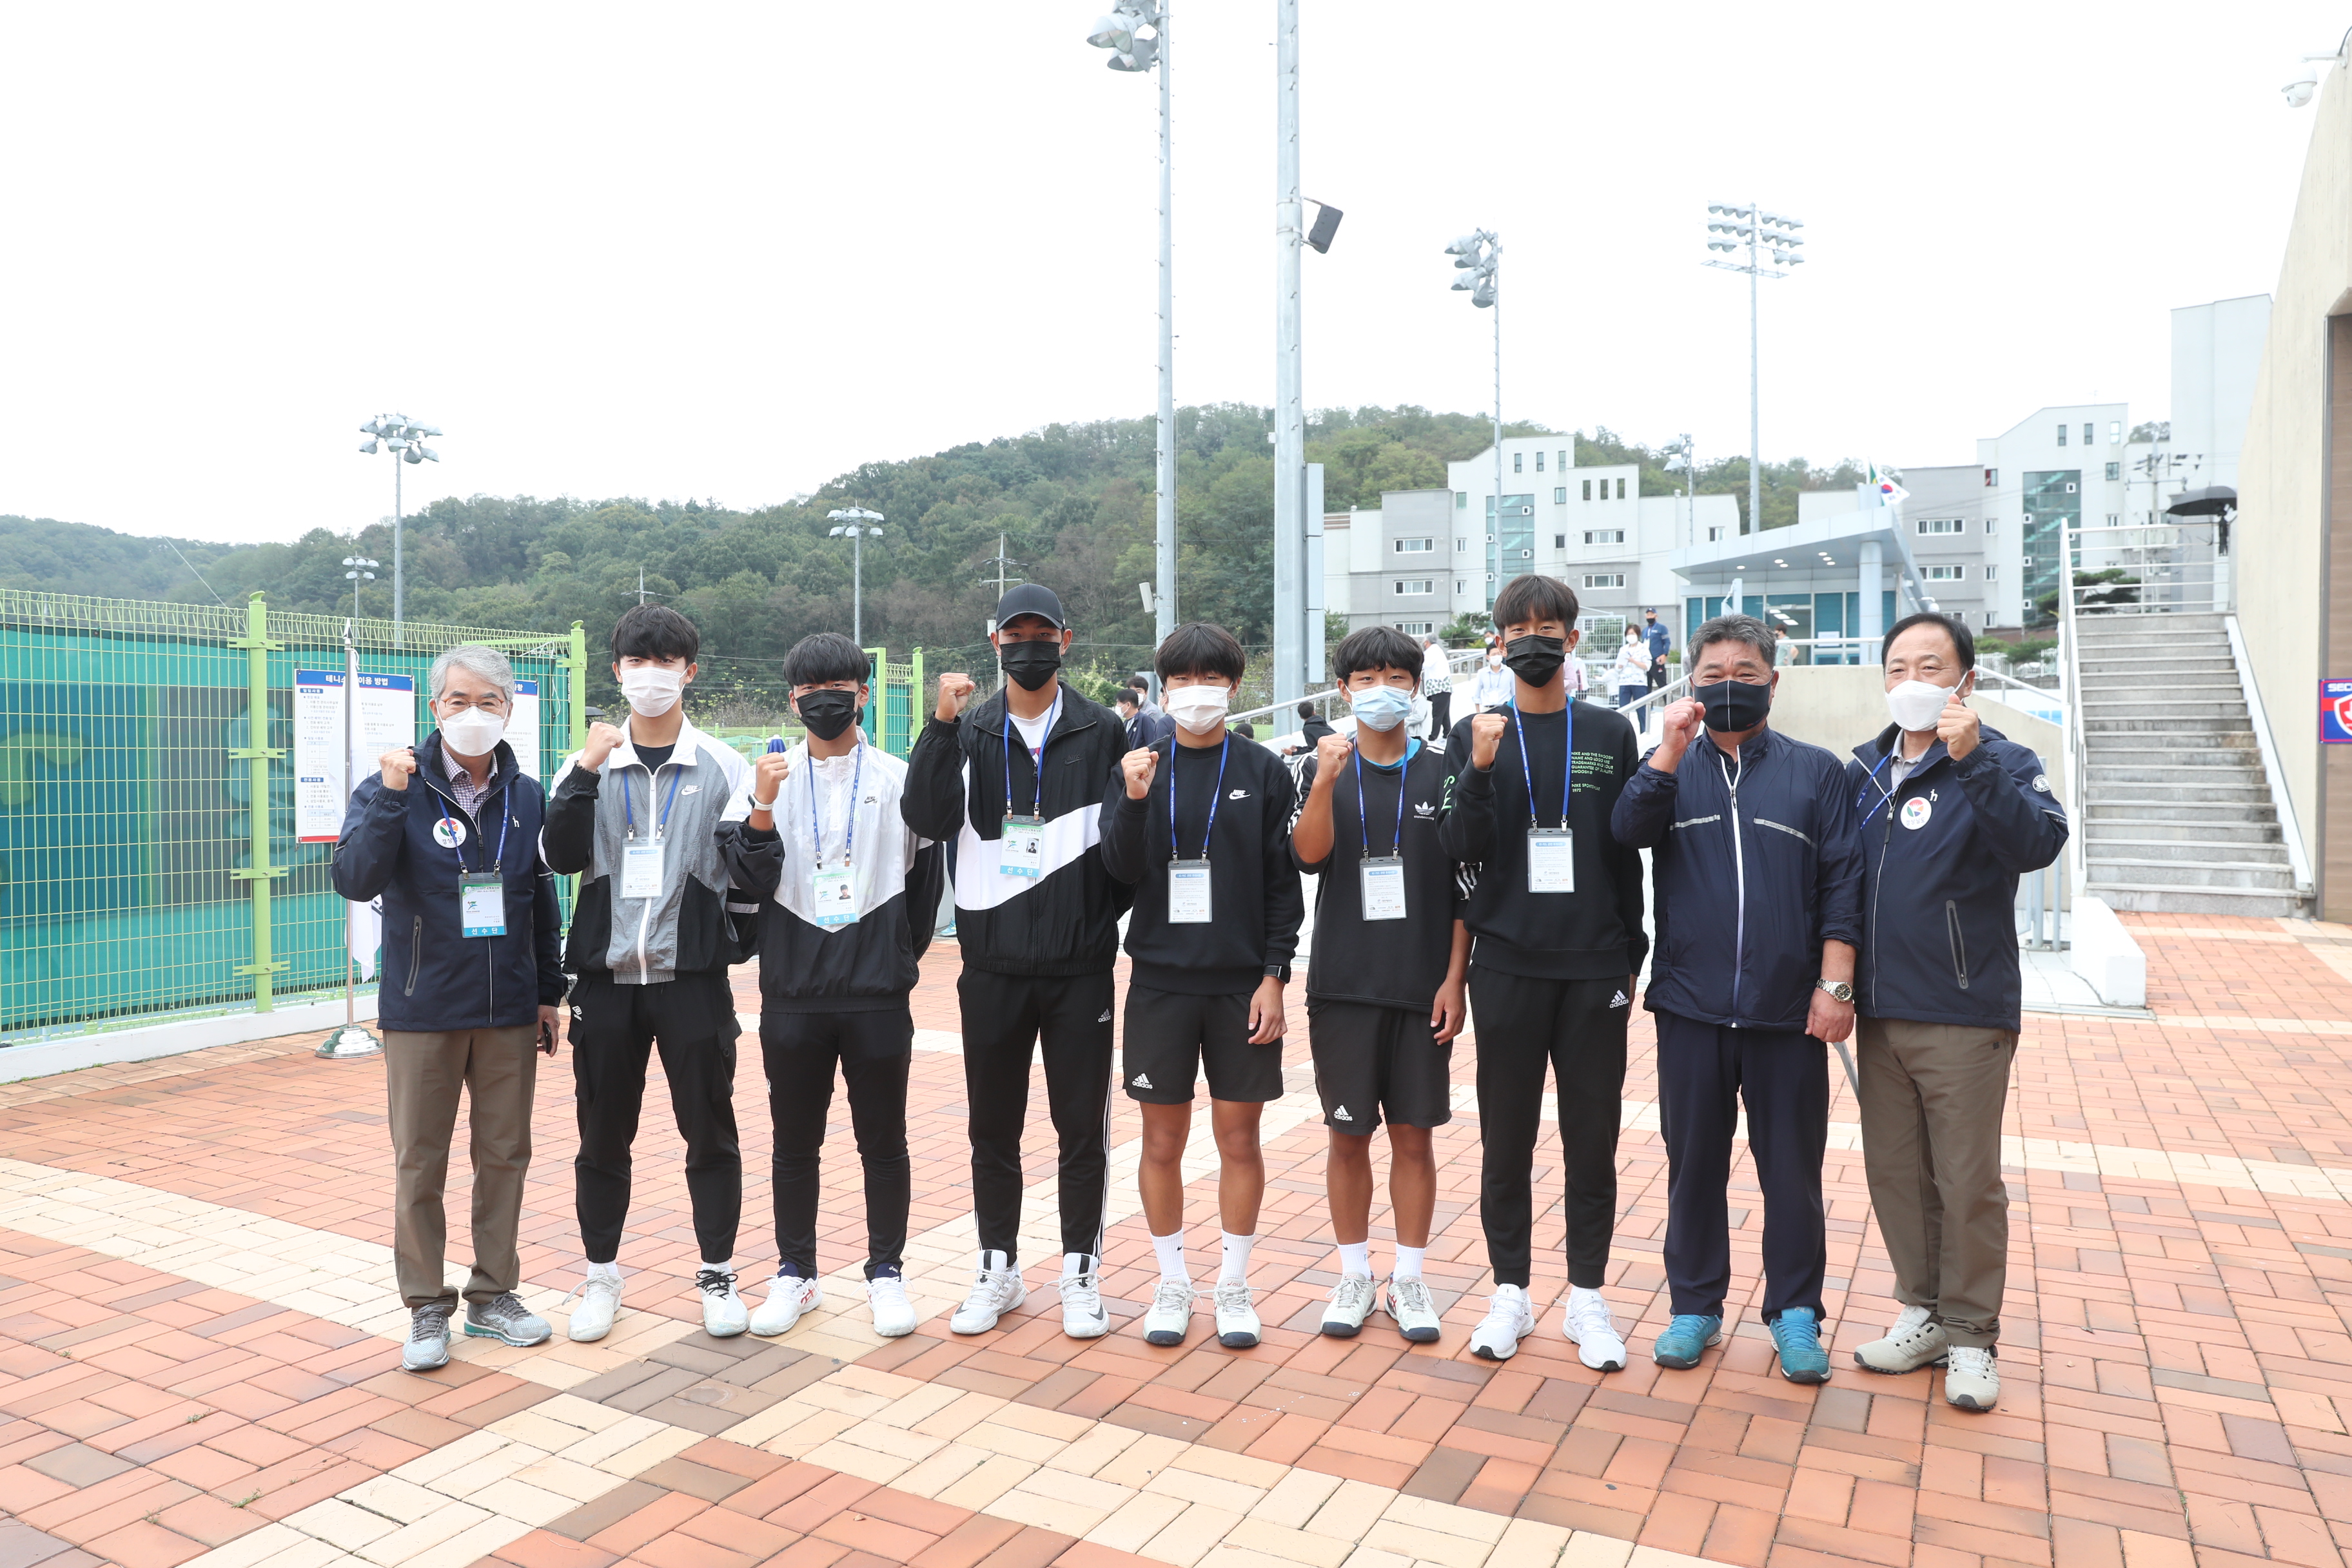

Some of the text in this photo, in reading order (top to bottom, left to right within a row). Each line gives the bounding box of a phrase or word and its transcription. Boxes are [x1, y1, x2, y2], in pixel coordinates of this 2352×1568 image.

[358, 676, 373, 685] 이용
[374, 677, 388, 686] 방법
[2328, 683, 2352, 692] SEC
[1906, 817, 1926, 826] 경상남도
[442, 836, 463, 845] 경상도
[1007, 867, 1034, 876] 선수단
[823, 915, 850, 923] 선수단
[1609, 999, 1629, 1008] adidas
[1132, 1081, 1153, 1089] adidas
